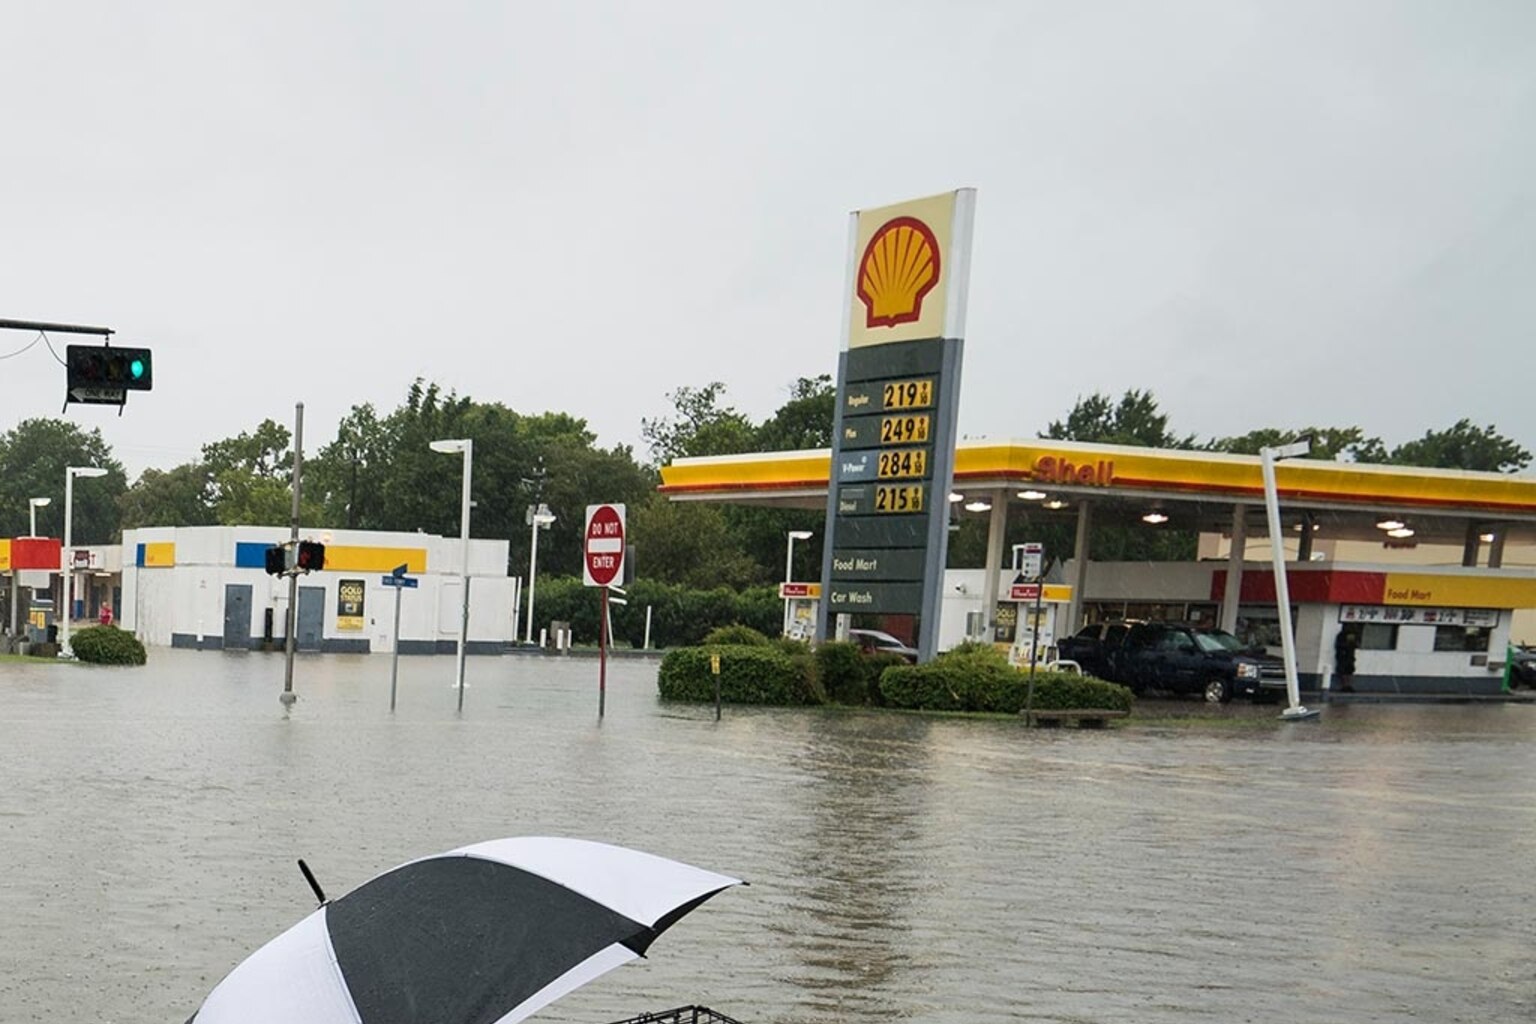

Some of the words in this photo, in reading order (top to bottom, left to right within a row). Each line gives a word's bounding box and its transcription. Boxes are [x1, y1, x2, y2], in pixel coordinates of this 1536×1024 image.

[848, 394, 870, 408] Regular
[885, 383, 918, 407] 219
[883, 418, 915, 442] 249
[881, 452, 911, 475] 284
[1033, 456, 1114, 485] Shell
[877, 487, 908, 510] 215
[592, 522, 602, 535] DO
[604, 522, 618, 534] NOT
[592, 556, 615, 568] ENTER
[833, 560, 853, 571] Food
[855, 559, 877, 570] Mart
[340, 586, 363, 595] GOLD
[830, 592, 846, 602] Car
[848, 591, 872, 603] Wash
[1387, 589, 1409, 600] Food
[1410, 590, 1431, 600] Mart
